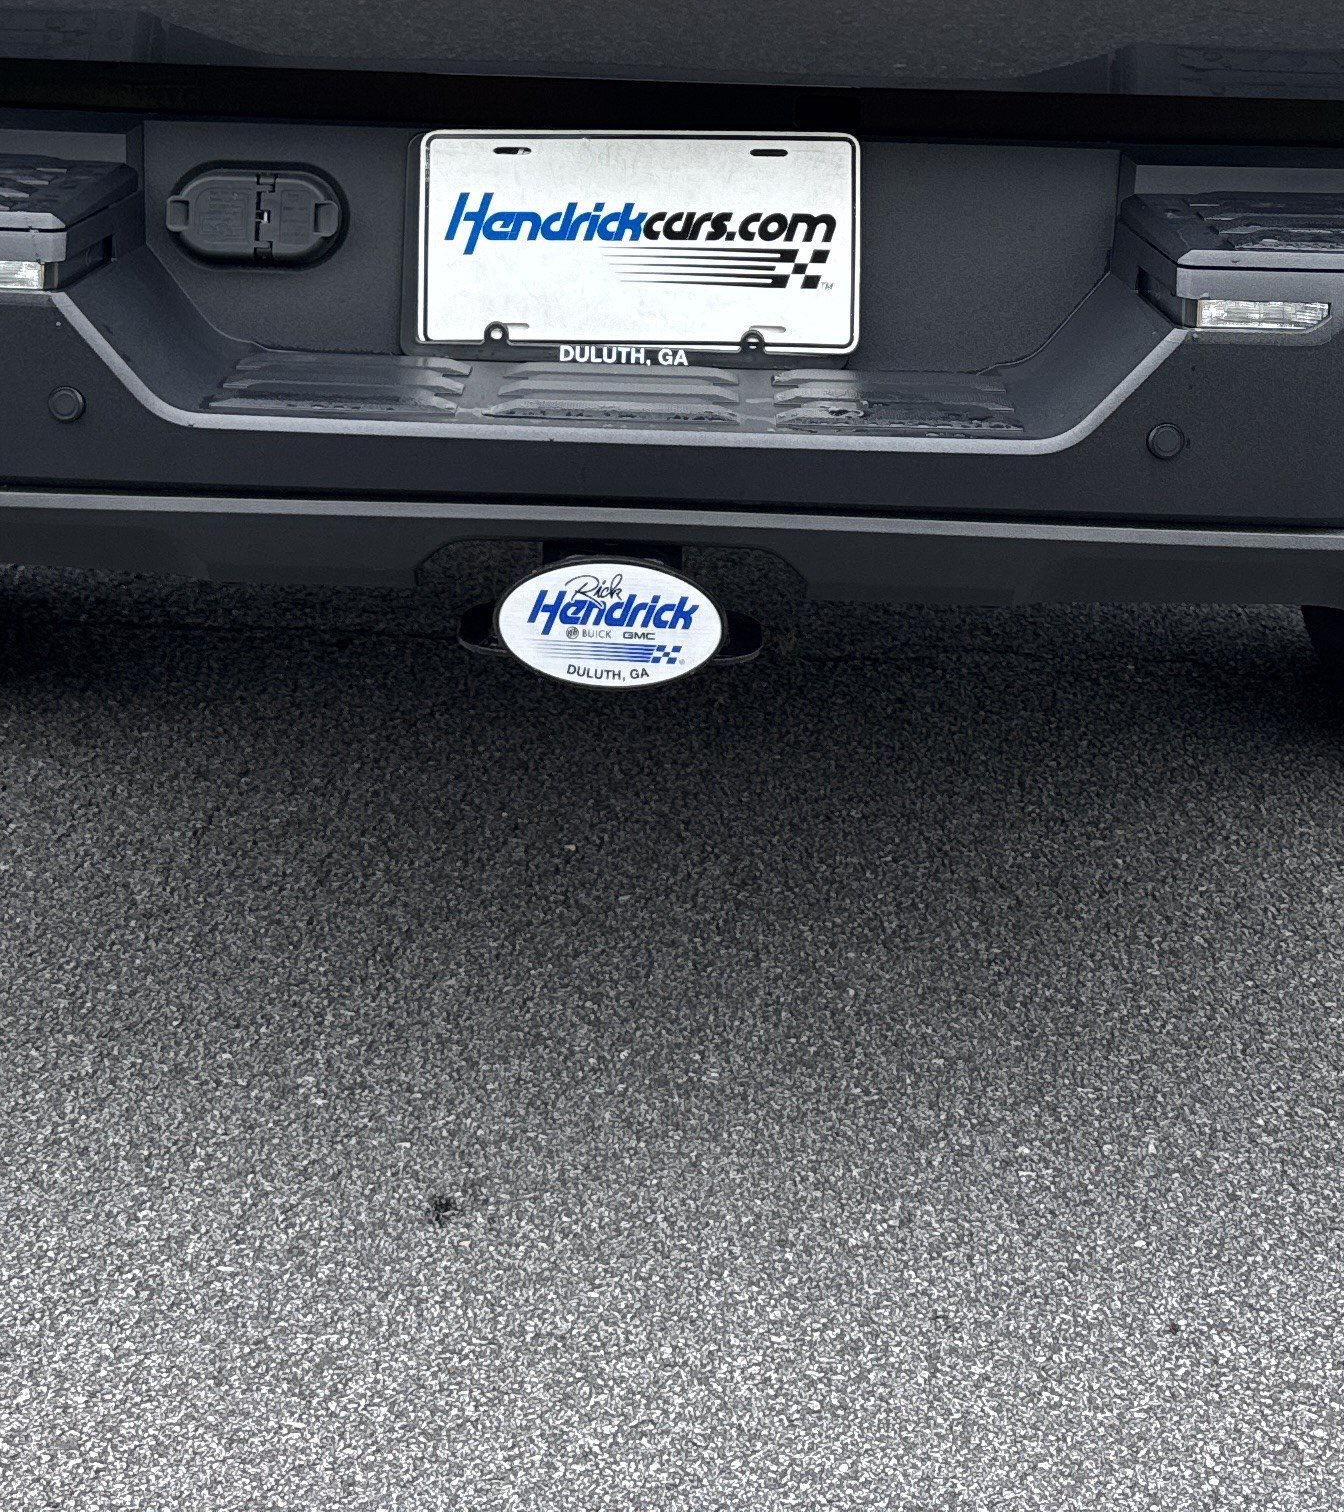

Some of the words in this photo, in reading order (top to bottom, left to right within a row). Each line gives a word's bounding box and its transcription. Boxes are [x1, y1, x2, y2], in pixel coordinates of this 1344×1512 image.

[444, 192, 837, 255] Hendrickcars.com
[559, 345, 652, 367] DULUTH,
[658, 348, 688, 366] GA
[565, 574, 623, 608] Rick
[527, 590, 699, 636] Hendrick
[582, 628, 612, 639] BUICK
[623, 632, 656, 640] GMC
[567, 664, 626, 682] DULUTH,
[629, 668, 650, 679] GA
